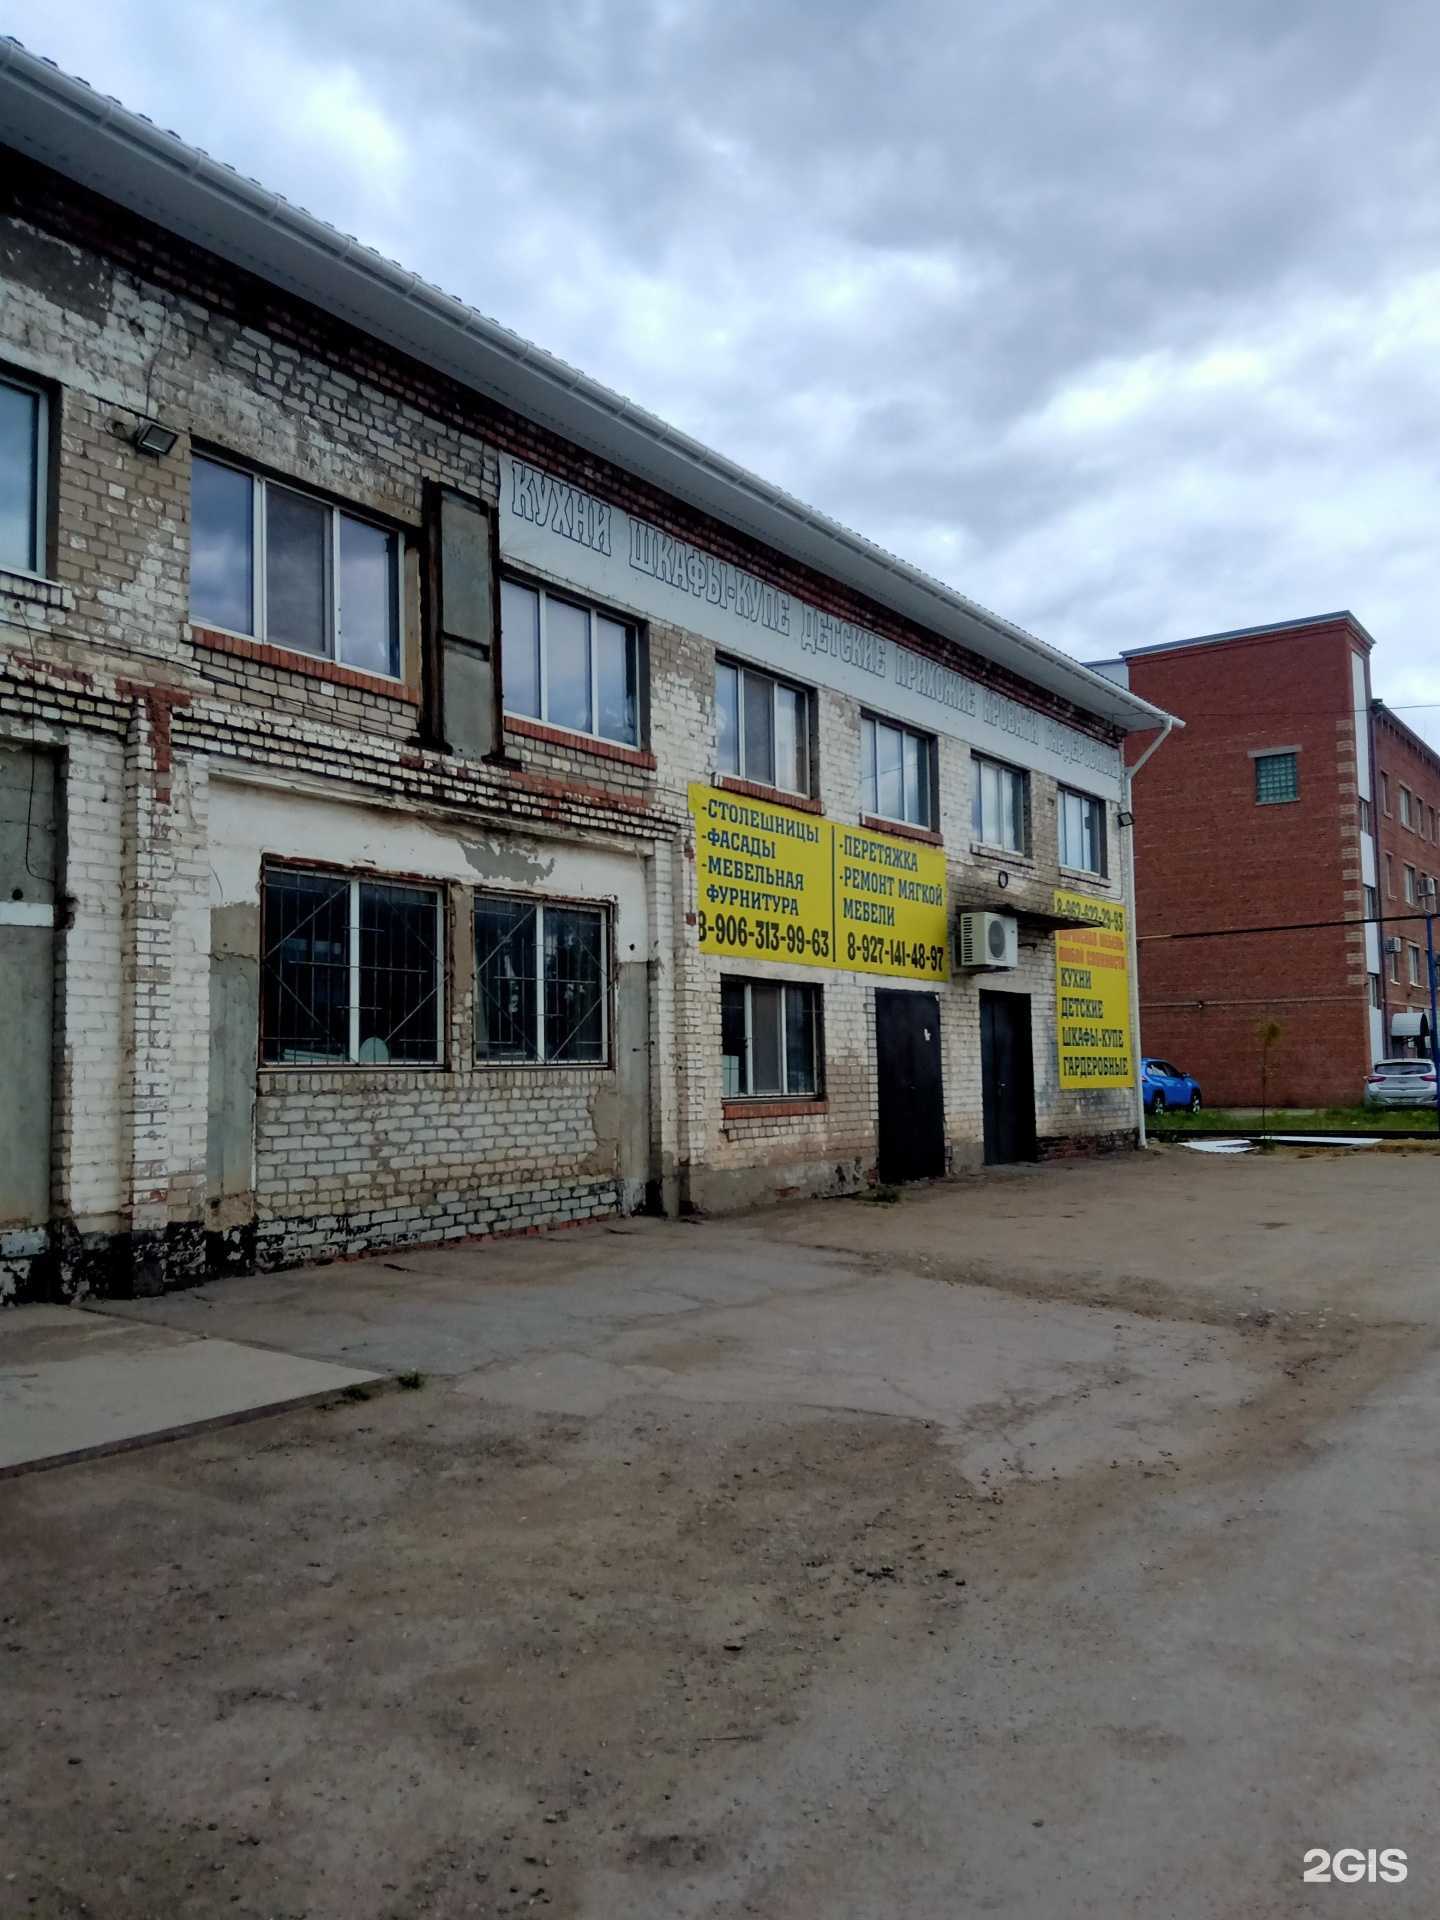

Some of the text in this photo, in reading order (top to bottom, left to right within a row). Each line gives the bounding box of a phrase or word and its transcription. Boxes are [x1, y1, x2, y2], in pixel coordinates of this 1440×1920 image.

[511, 460, 612, 557] КУХНИ
[628, 517, 791, 636] ШКАФЫ-КУПЕ
[801, 602, 887, 679] ДЕТСКИЕ
[896, 645, 976, 717] ПРИХОЖИЕ
[706, 884, 800, 917] ФУРНИТУРА
[898, 880, 943, 906] МЯГКОЙ
[843, 898, 896, 927] МЕБЕЛИ
[847, 932, 945, 973] 8-927-141-48-97
[1060, 967, 1092, 990] КУХНИ
[1061, 997, 1104, 1019] ДЕТСКИЕ
[1062, 1027, 1124, 1049] ШКАФЫ-КУПЕ
[1063, 1056, 1129, 1078] ГАРДЕРОБНЫЕ
